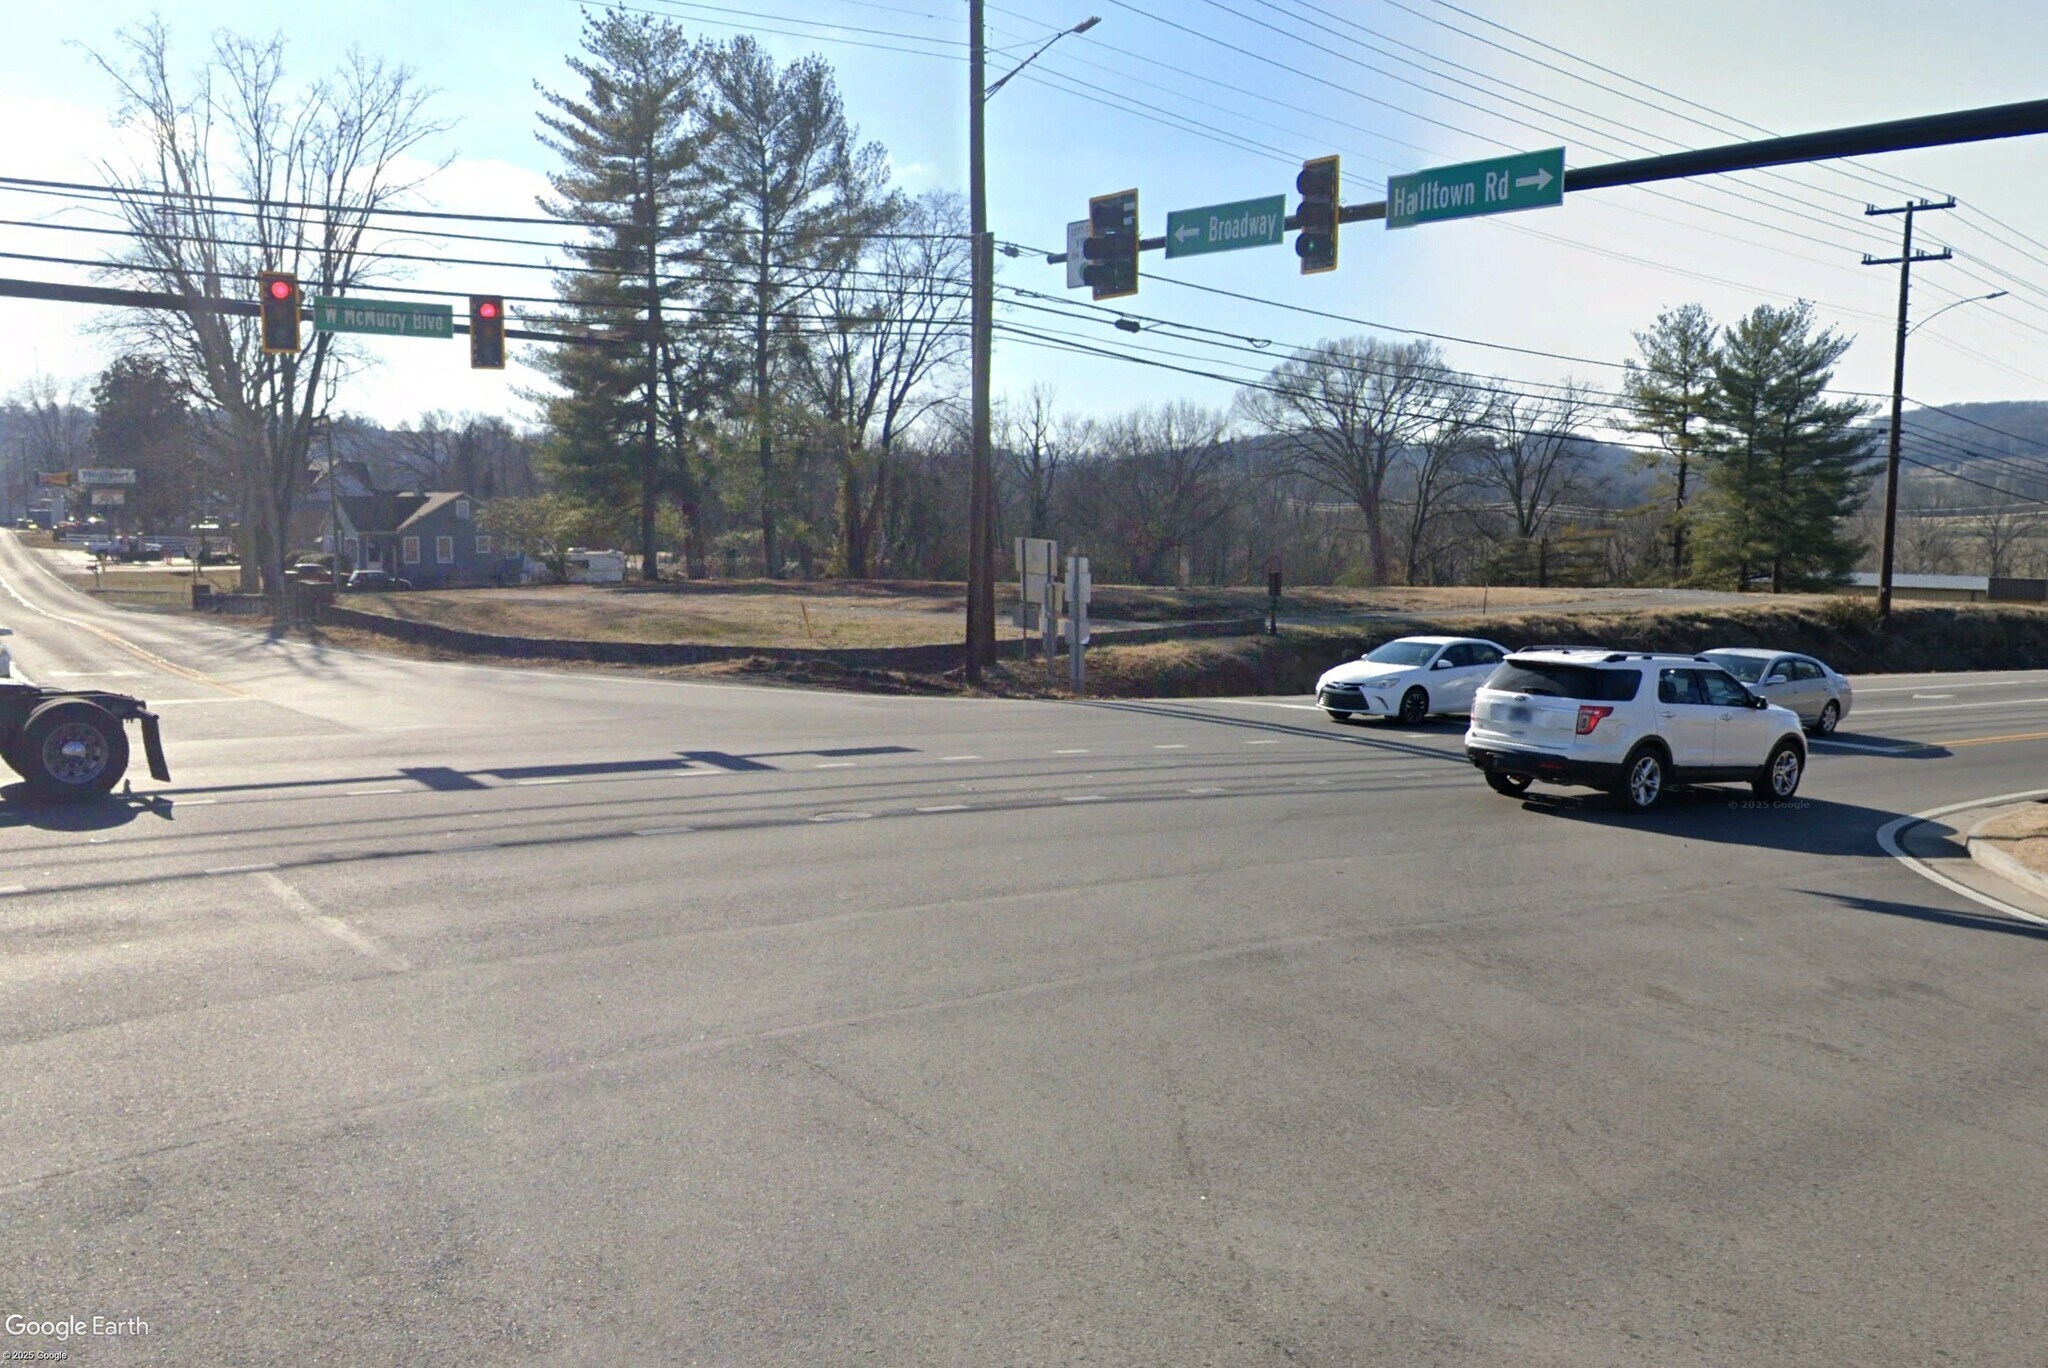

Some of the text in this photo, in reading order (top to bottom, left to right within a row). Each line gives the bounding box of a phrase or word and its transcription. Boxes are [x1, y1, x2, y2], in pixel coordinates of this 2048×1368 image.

[1394, 169, 1509, 217] Halltown Rd
[1209, 211, 1277, 242] Broadway
[325, 304, 444, 333] W McMurry Blvd
